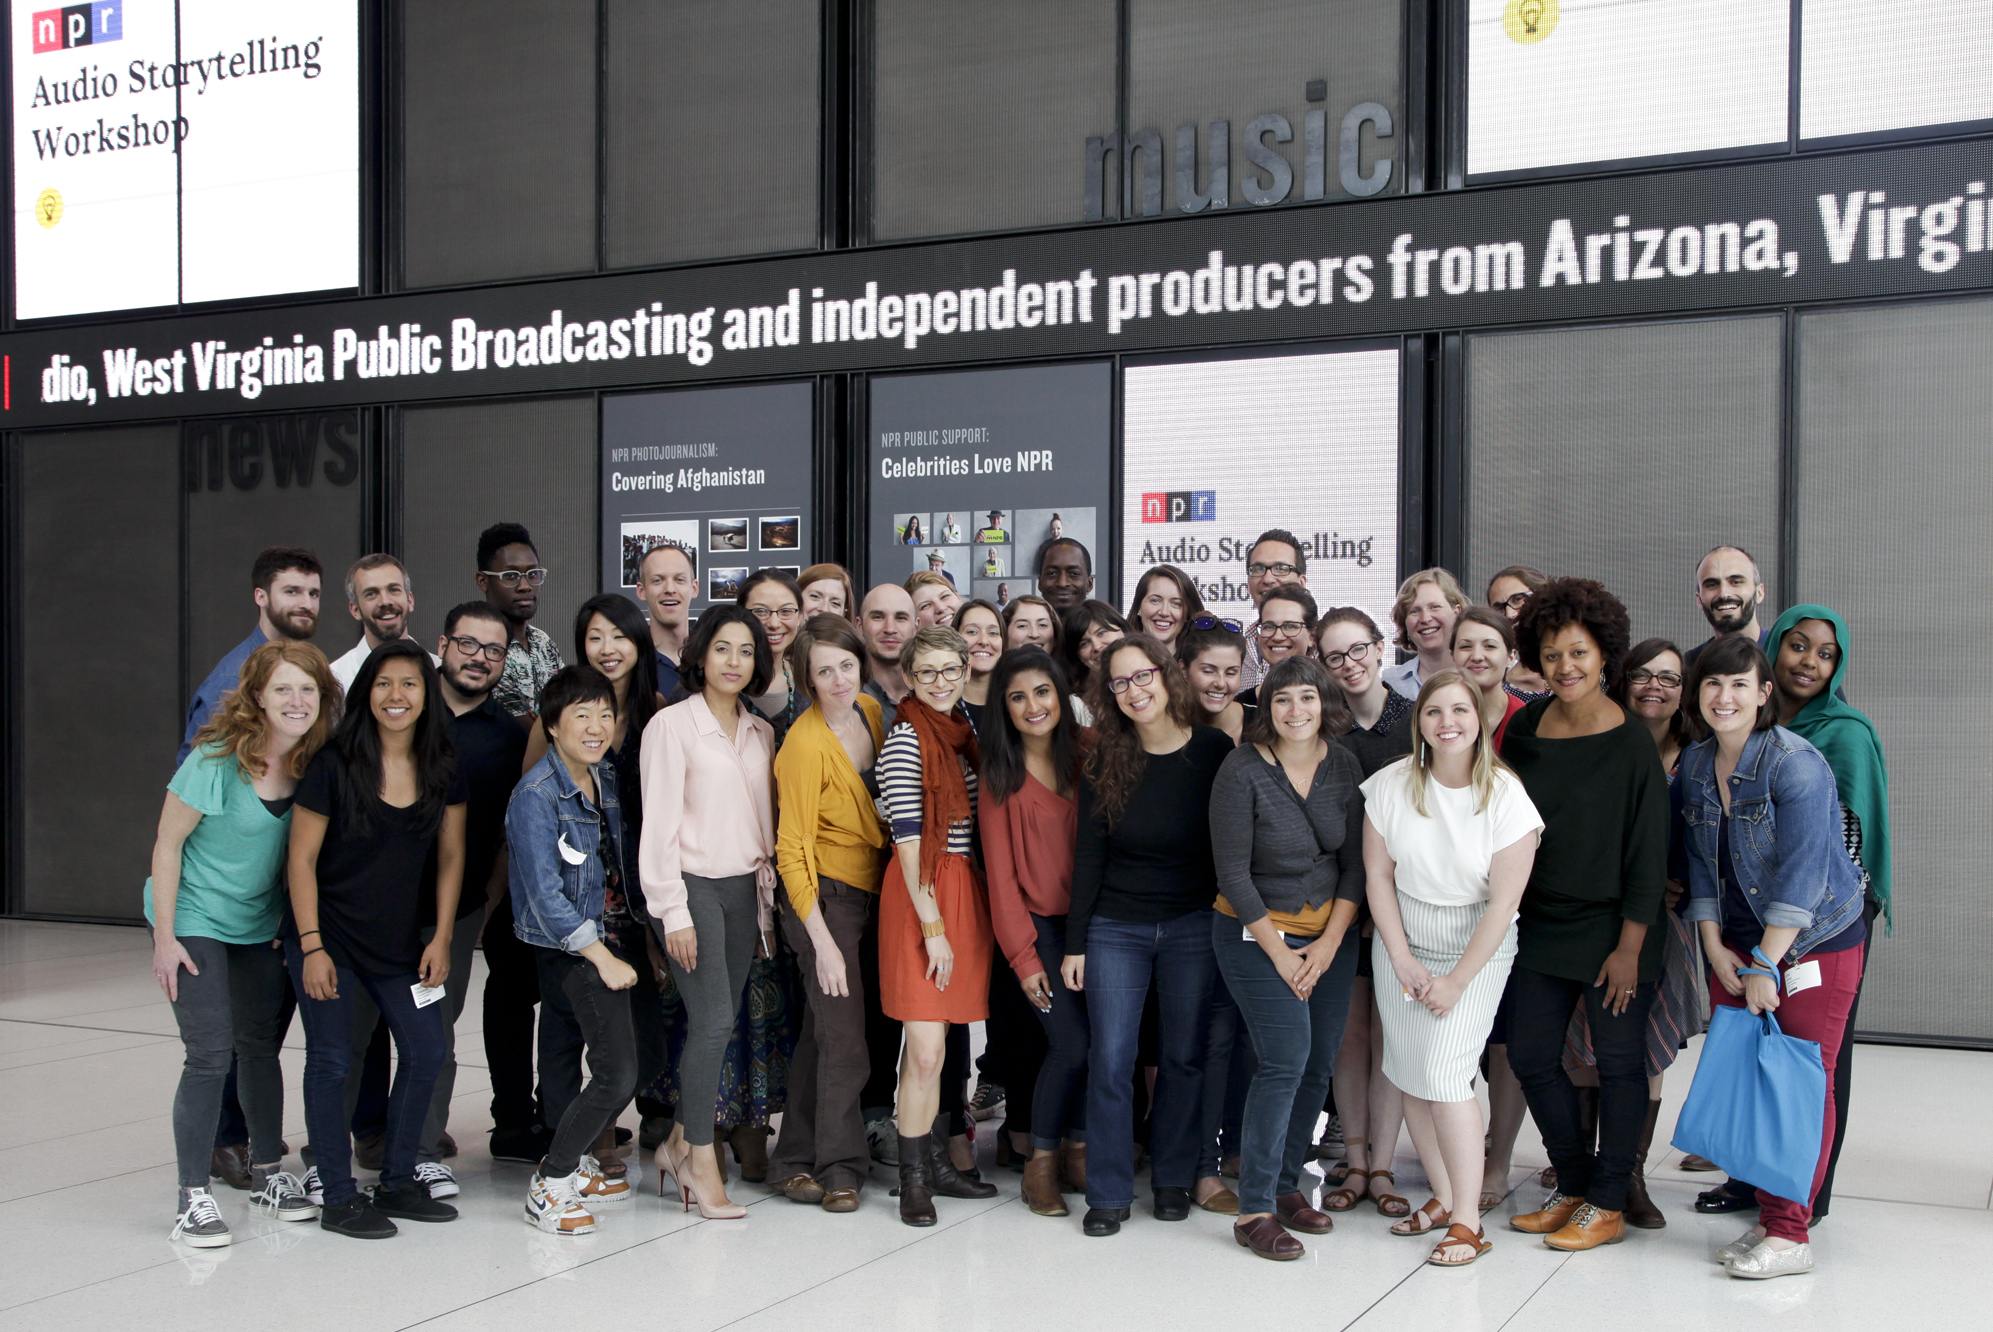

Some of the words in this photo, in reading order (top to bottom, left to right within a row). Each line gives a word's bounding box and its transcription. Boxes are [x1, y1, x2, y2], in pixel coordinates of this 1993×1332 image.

[39, 7, 115, 48] npr
[31, 66, 118, 108] Audio
[129, 36, 323, 95] Storytelling
[32, 113, 190, 161] Workshop
[1085, 79, 1393, 223] music
[41, 354, 97, 406] dio,
[103, 347, 187, 398] West
[191, 334, 325, 399] Virginia
[333, 323, 443, 381] Public
[451, 302, 716, 372] Broadcasting
[722, 288, 801, 351] and
[812, 269, 1098, 349] independent
[1108, 250, 1374, 334] producers
[1386, 233, 1525, 299] from
[1539, 215, 1798, 287] Arizona,
[1818, 182, 1993, 273] Virgi
[185, 408, 359, 493] news
[611, 448, 630, 463] NPR
[631, 442, 719, 461] PHOTOJOURNALISM:
[881, 432, 901, 448] NPR
[904, 429, 939, 447] PUBLIC
[941, 427, 990, 445] SUPPORT:
[611, 470, 674, 493] Covering
[677, 466, 766, 492] Afghanistan
[881, 456, 969, 479] Celebrities
[973, 453, 1012, 475] Love
[1017, 450, 1053, 473] NPR
[1146, 495, 1208, 523] npr
[1139, 536, 1211, 564] Audio
[1218, 532, 1374, 568] Stelling
